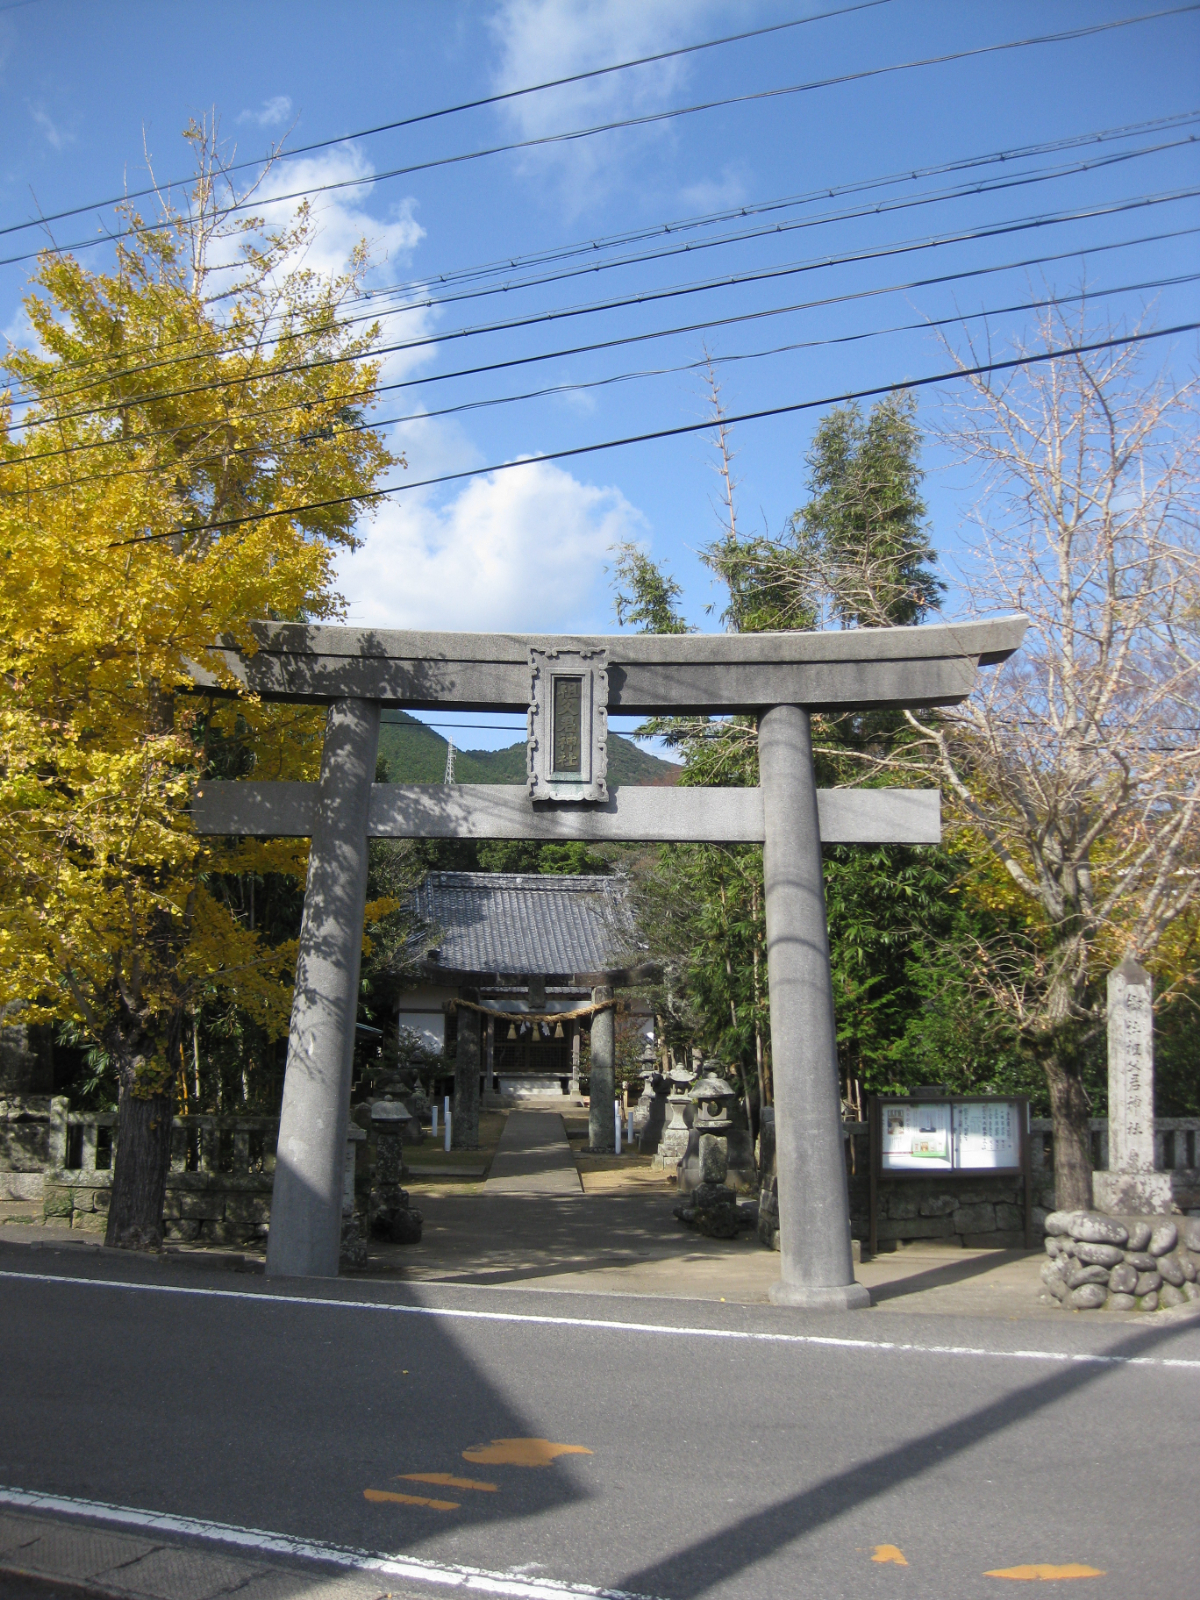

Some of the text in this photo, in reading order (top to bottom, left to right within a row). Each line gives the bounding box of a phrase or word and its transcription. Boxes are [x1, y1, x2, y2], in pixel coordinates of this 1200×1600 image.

[556, 682, 580, 768] 祖父君神社
